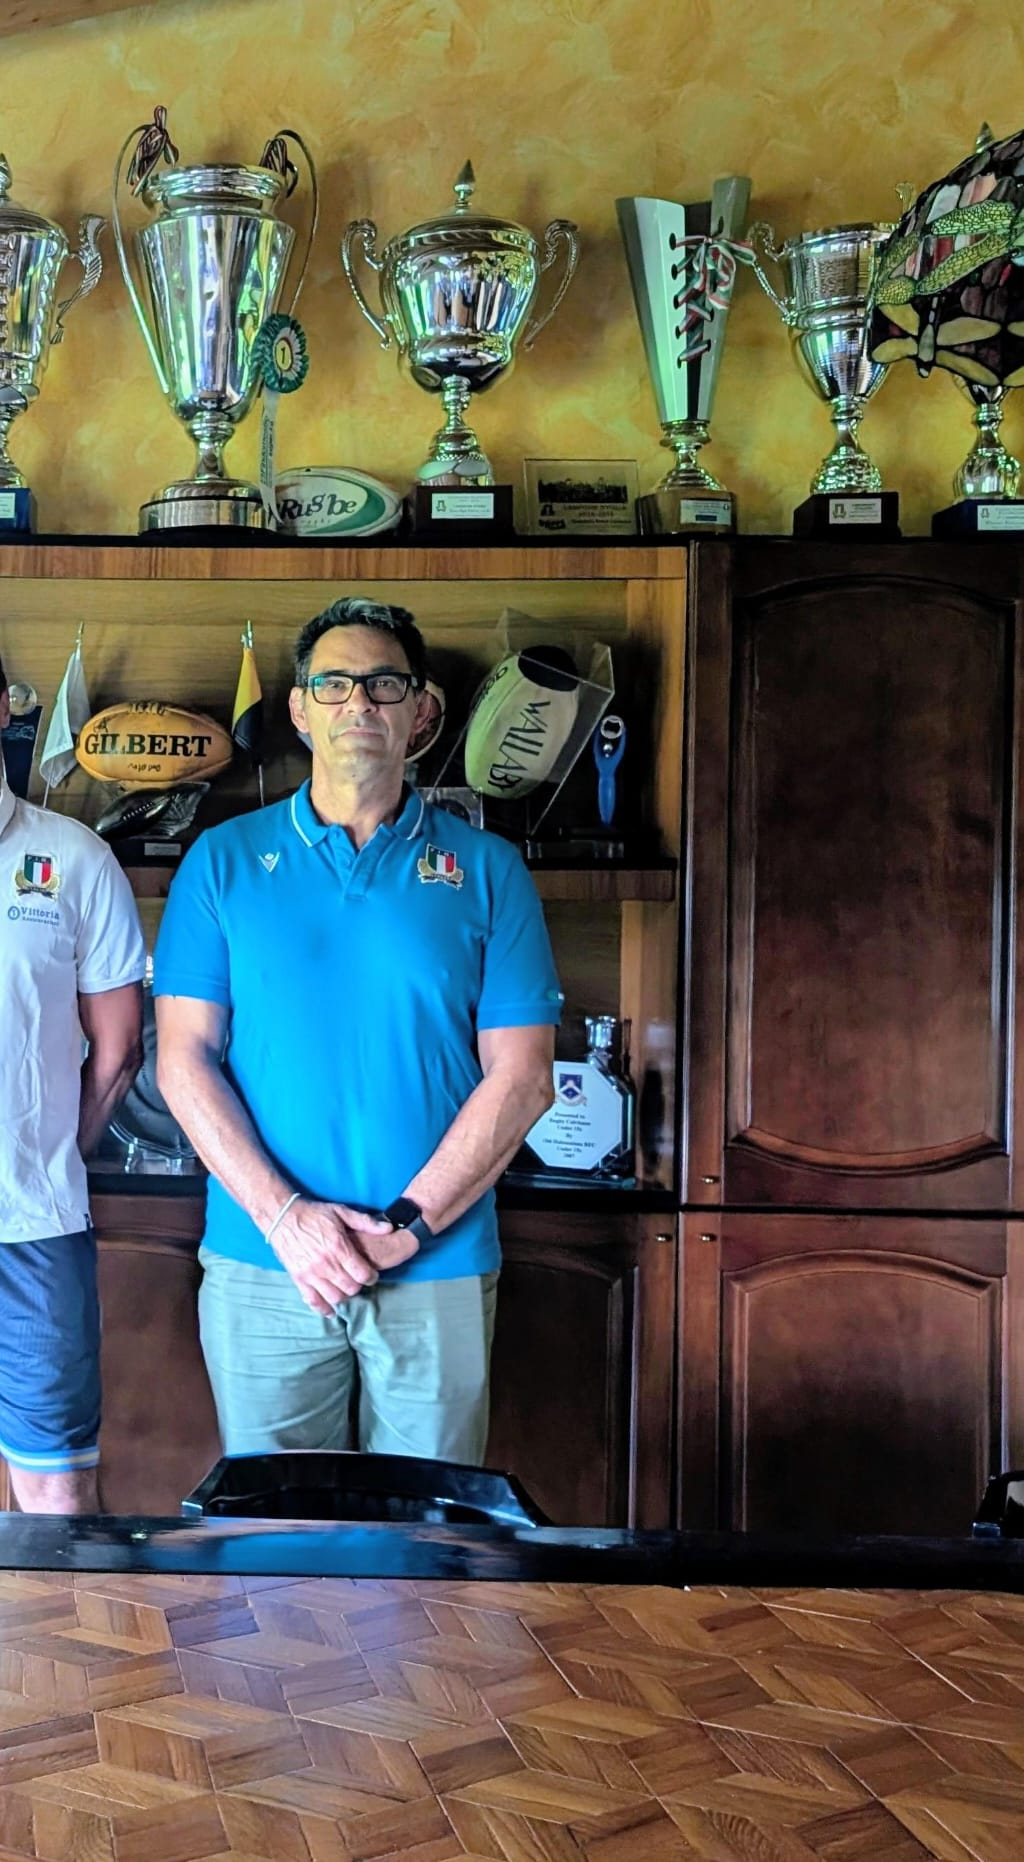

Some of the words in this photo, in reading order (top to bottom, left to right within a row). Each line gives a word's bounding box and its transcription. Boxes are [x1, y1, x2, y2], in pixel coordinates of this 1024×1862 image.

[281, 346, 286, 364] 1
[84, 733, 212, 758] GILBERT
[488, 700, 551, 792] WALLABY
[21, 906, 60, 920] Vittoria
